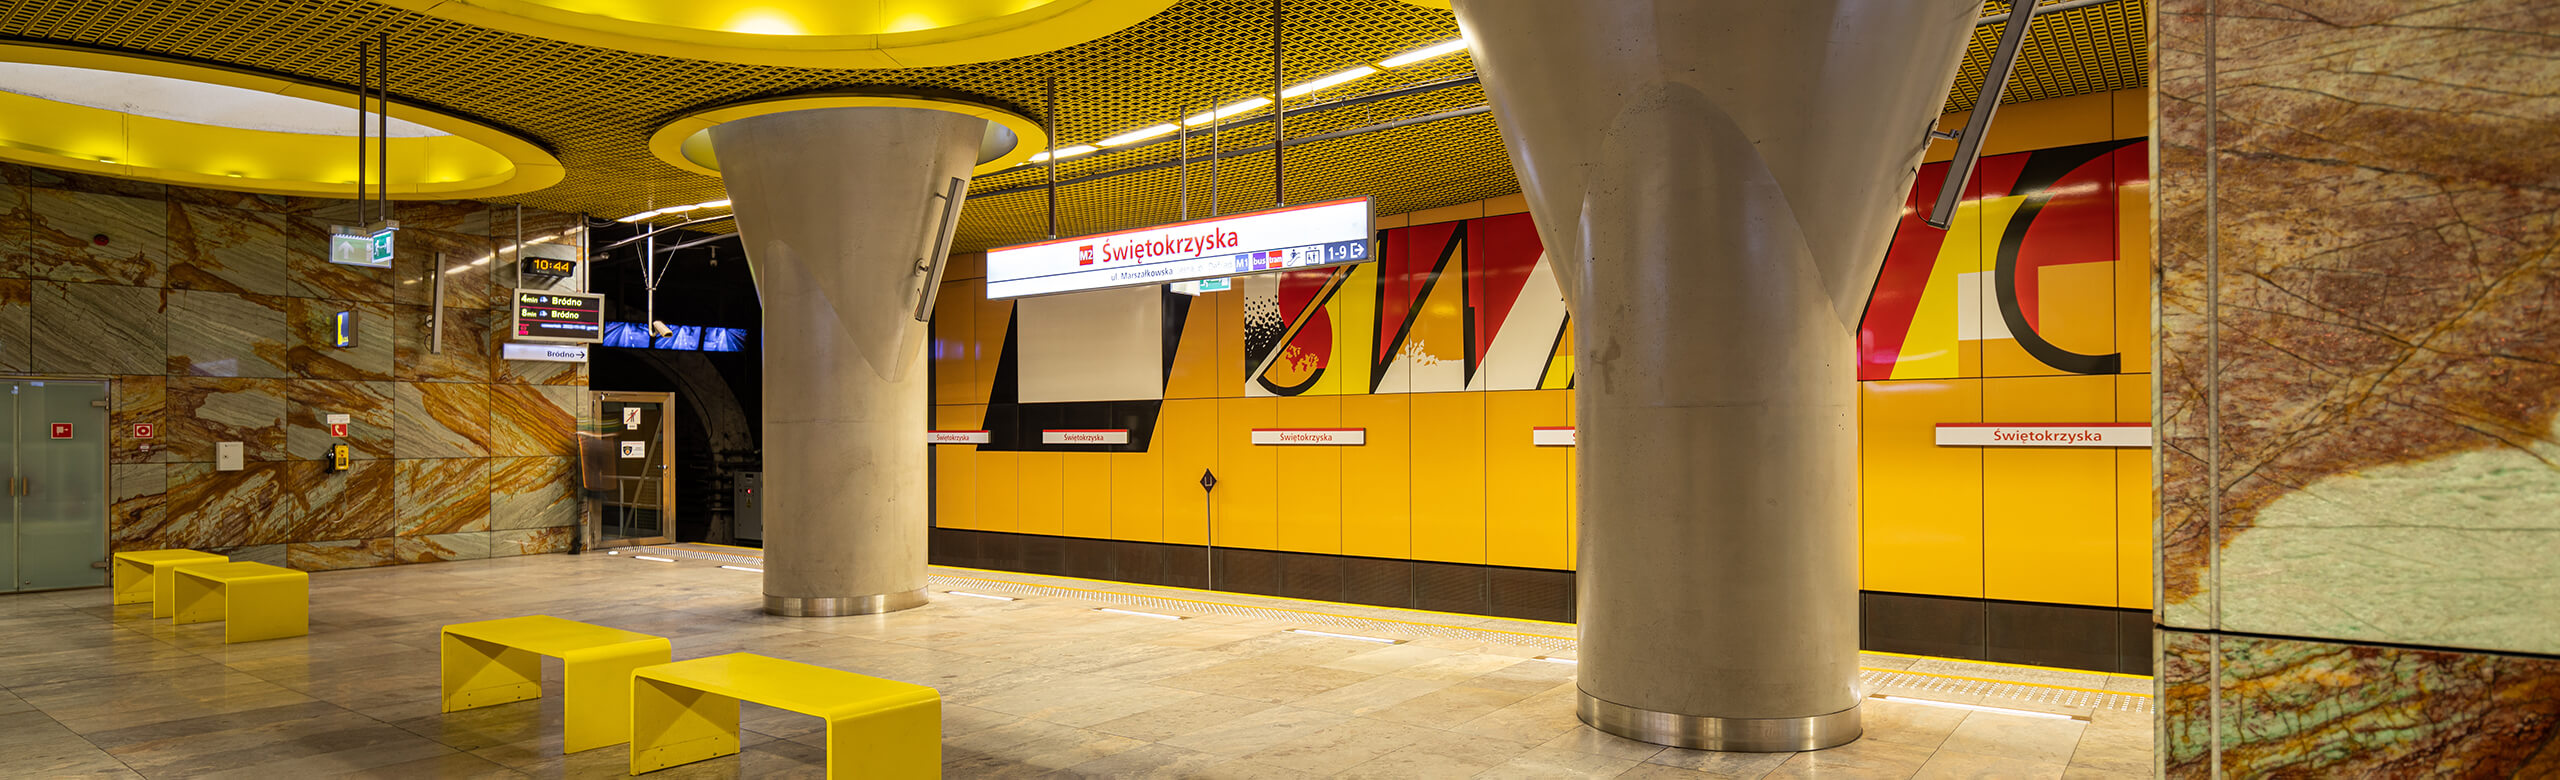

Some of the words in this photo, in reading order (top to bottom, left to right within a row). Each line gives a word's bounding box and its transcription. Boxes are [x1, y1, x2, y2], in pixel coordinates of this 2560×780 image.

[1080, 249, 1093, 261] M2
[1103, 227, 1238, 264] Świętokrzyska
[1328, 245, 1347, 260] 1-9
[1236, 258, 1248, 268] M1
[1253, 255, 1266, 265] bus
[1269, 255, 1282, 263] tram
[533, 259, 569, 272] 10:44
[1111, 274, 1119, 282] ul.
[1121, 268, 1173, 280] Marszałkowska
[552, 296, 582, 306] Bródno
[551, 310, 579, 319] Bródno
[547, 350, 575, 358] Bródno
[936, 433, 970, 442] Świętokrzyska
[1063, 433, 1104, 442] Świętokrzyska
[1280, 432, 1333, 442] Świętokrzyska
[1993, 428, 2102, 444] Świętokrzyska
